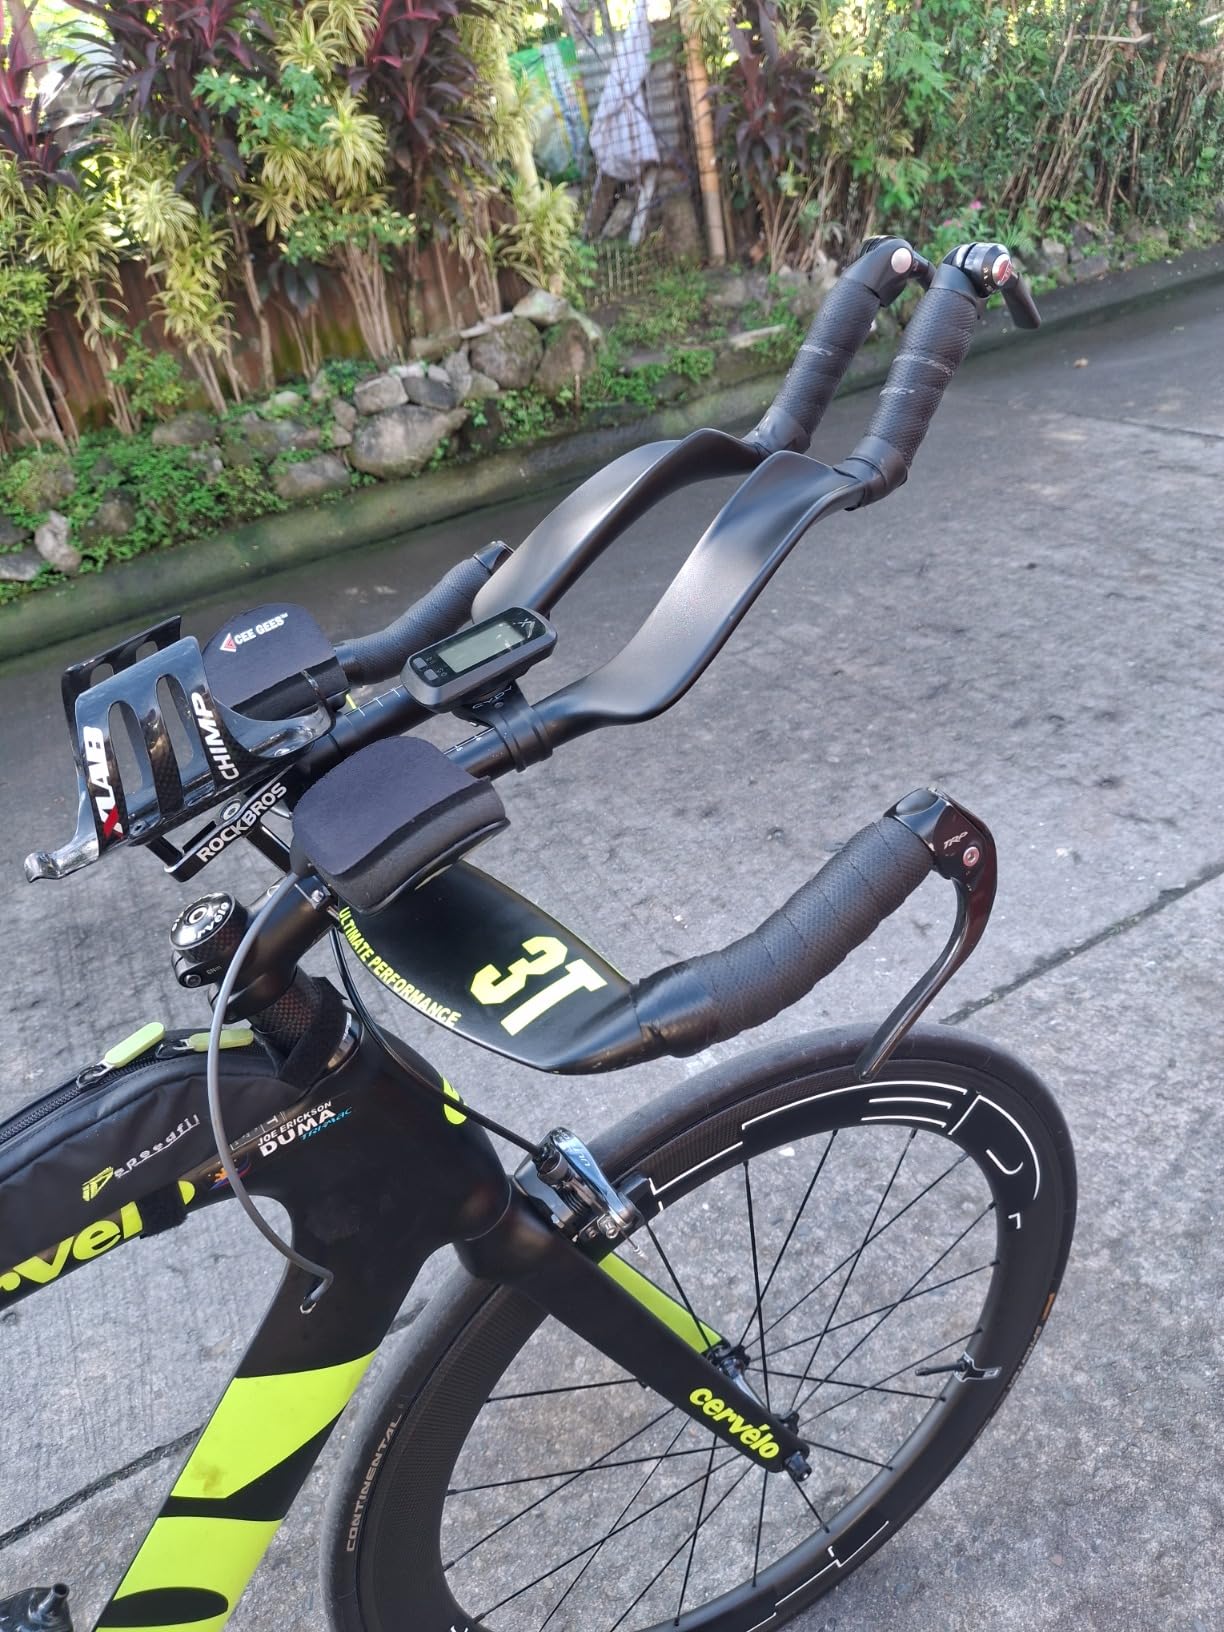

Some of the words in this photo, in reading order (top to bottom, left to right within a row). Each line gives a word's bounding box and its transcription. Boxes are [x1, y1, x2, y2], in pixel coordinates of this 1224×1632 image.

[233, 628, 257, 645] CEE
[191, 692, 240, 781] CHIMP
[83, 726, 125, 838] XLAB
[196, 782, 288, 863] ROCKBROS
[338, 906, 375, 962] ULTIMATE
[368, 955, 463, 1028] PERFORMANCE
[470, 935, 609, 1037] 3T
[257, 1130, 279, 1147] JOE
[279, 1100, 333, 1134] ERICKSON
[259, 1108, 337, 1158] DUMA
[689, 1387, 780, 1459] cervélo
[346, 1414, 403, 1552] CONTINENTAL
